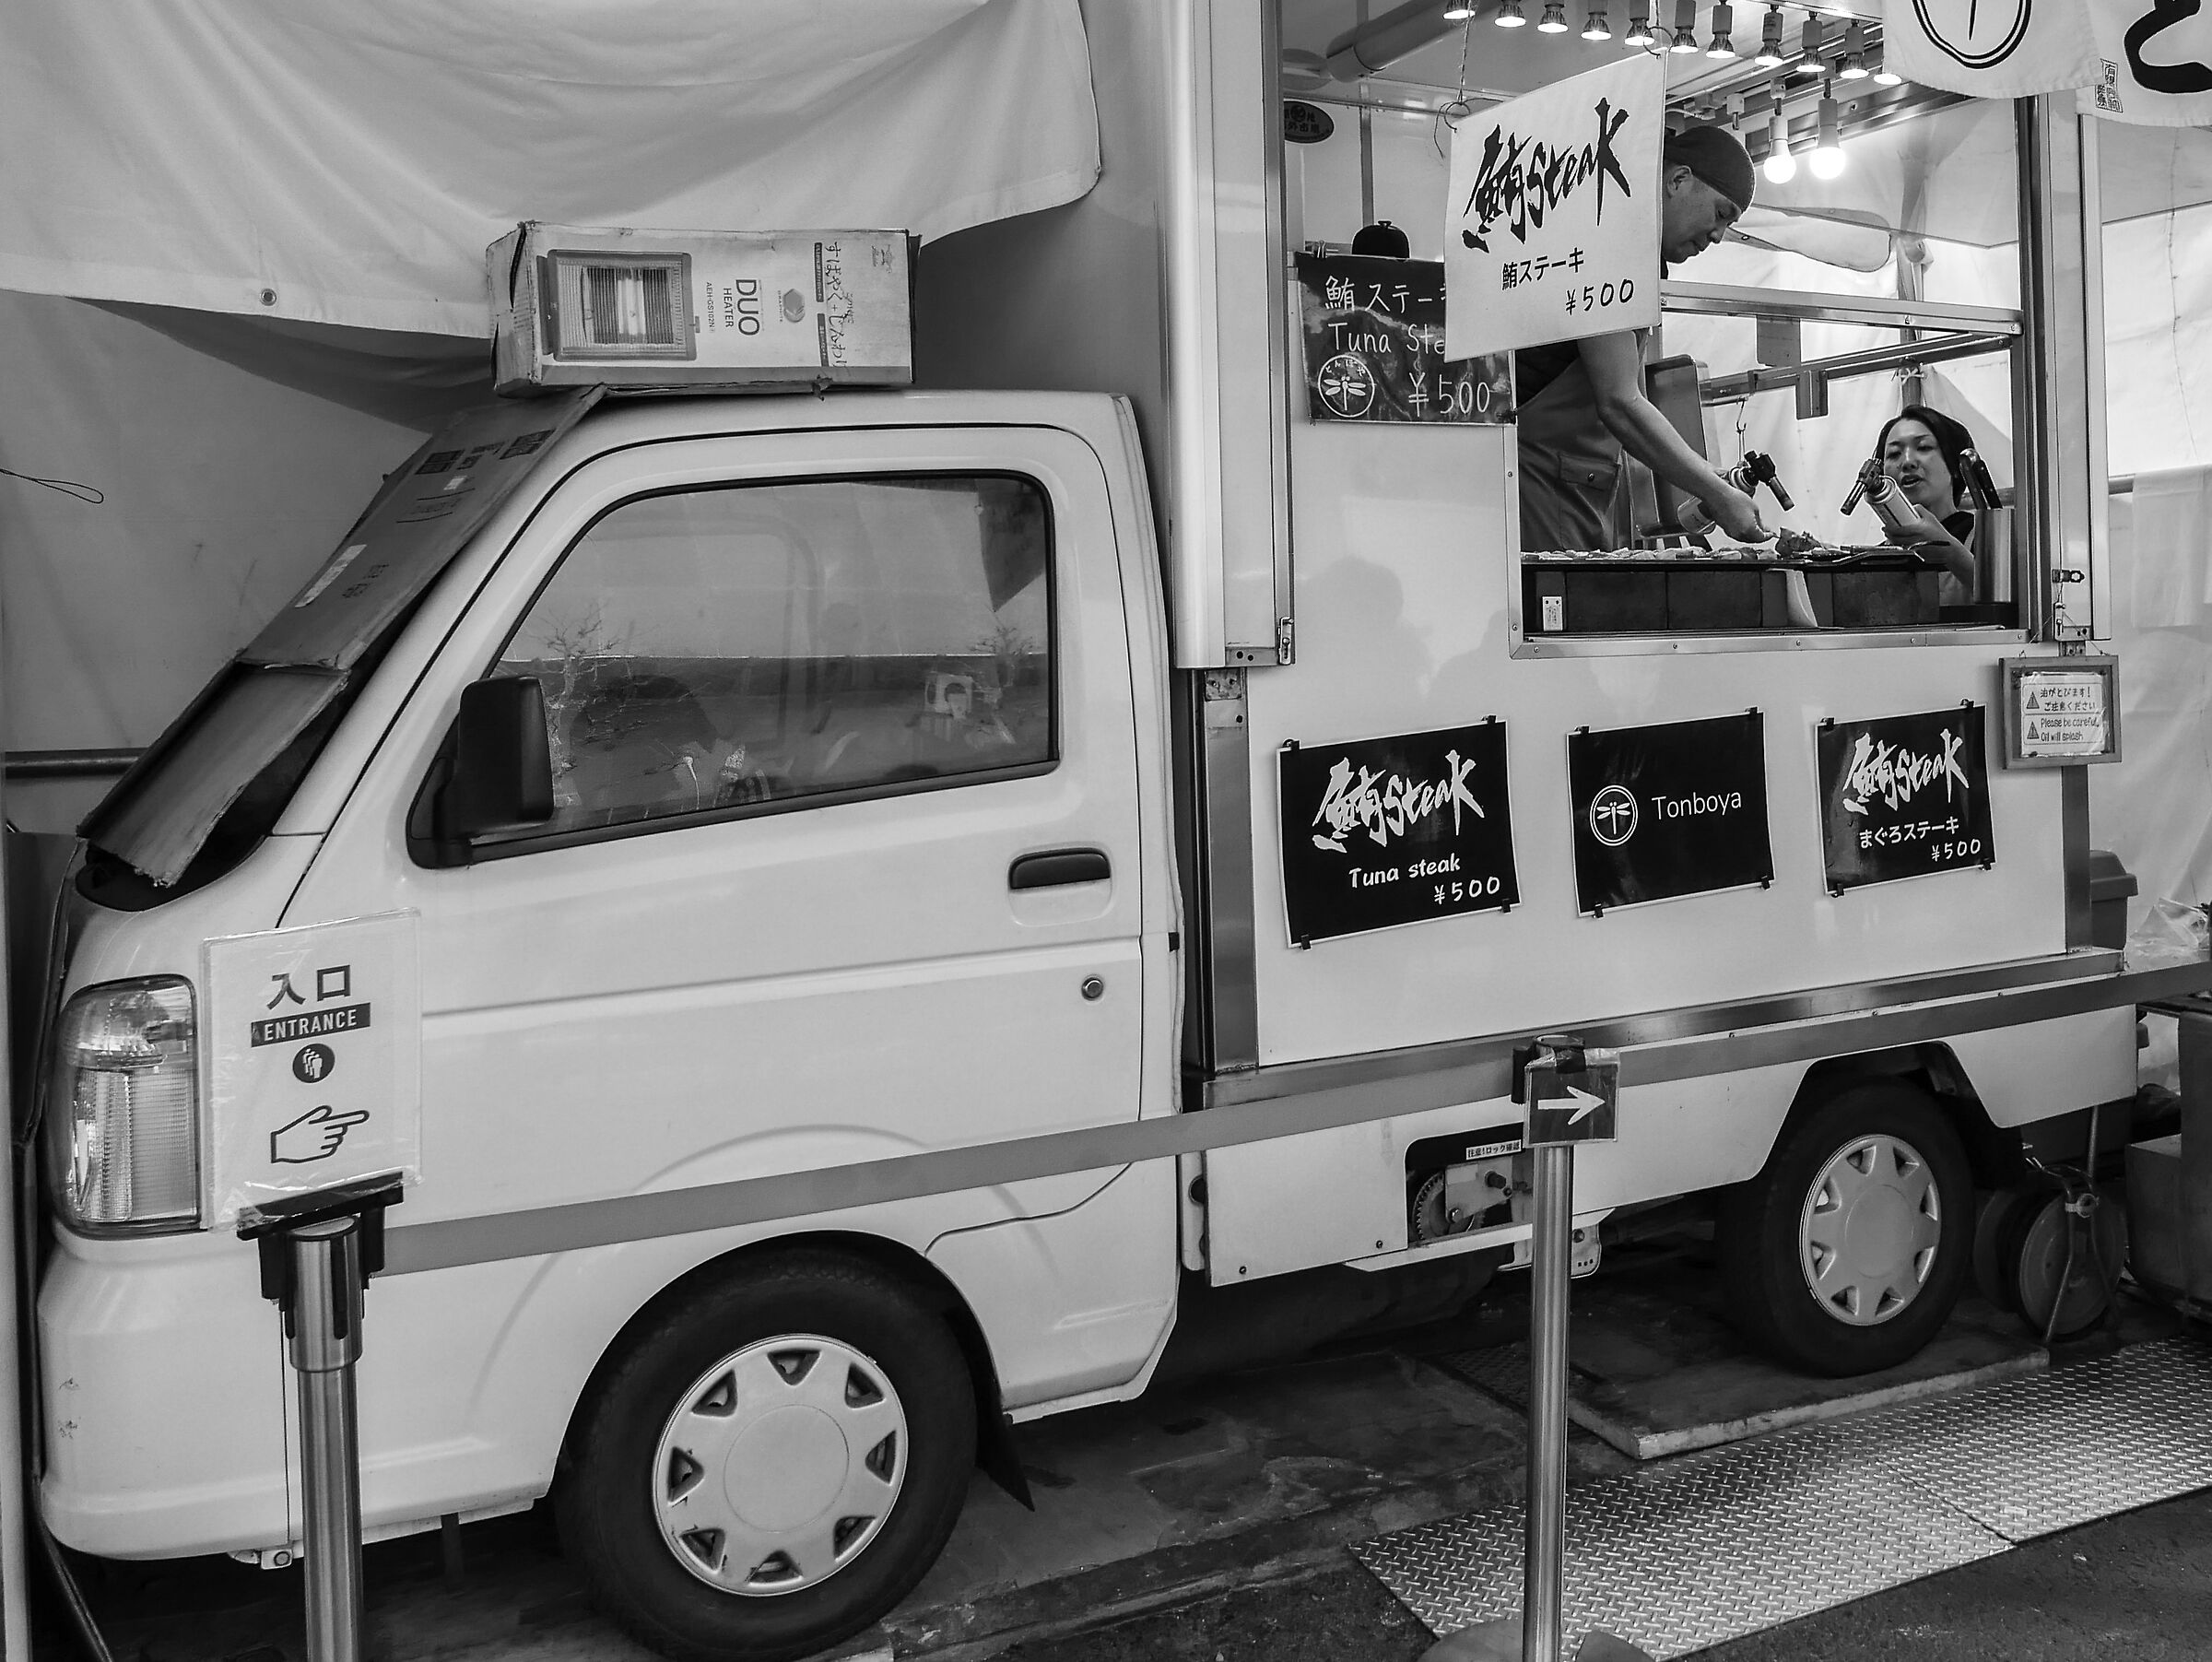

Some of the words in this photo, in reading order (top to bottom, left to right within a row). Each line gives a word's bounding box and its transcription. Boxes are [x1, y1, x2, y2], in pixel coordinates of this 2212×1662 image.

[1501, 247, 1584, 290] 鮪ステーキ
[723, 287, 734, 328] HEATER
[735, 279, 760, 336] DUO
[1325, 276, 1445, 313] 鮪ステー
[1566, 278, 1634, 315] ¥500
[1328, 323, 1392, 354] Tuna
[1406, 324, 1445, 354] Ste
[1408, 371, 1490, 417] ¥500
[2041, 718, 2063, 728] Please
[1652, 792, 1742, 820] Tonboya
[1859, 816, 1959, 848] まぐろステーキ
[1931, 839, 1981, 862] ¥500
[1349, 867, 1400, 889] Tuna
[1408, 853, 1461, 878] steak
[1434, 876, 1500, 904] ¥500
[266, 964, 351, 1010] 入口
[264, 1008, 358, 1043] ENTRANCE
